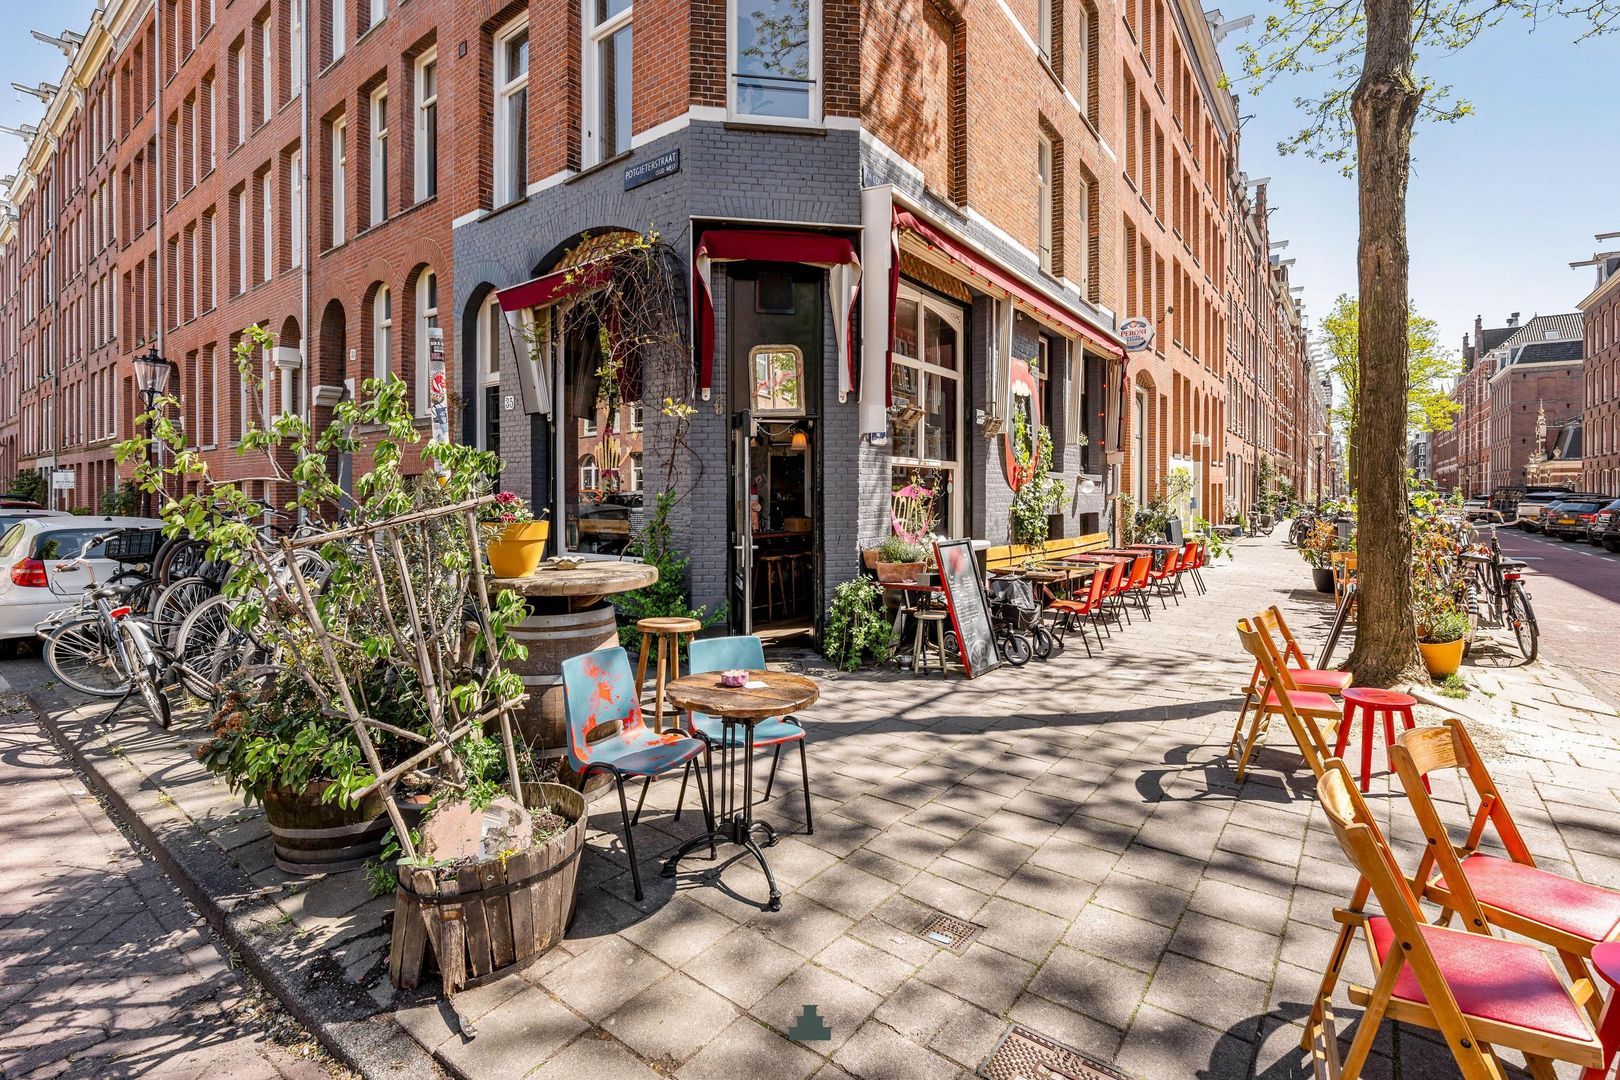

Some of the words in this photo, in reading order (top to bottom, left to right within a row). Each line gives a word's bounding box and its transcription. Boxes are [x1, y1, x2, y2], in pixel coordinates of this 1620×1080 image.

[625, 152, 676, 180] POTGIETERSTRAAT
[1120, 329, 1147, 337] PERONI
[505, 398, 513, 408] 35
